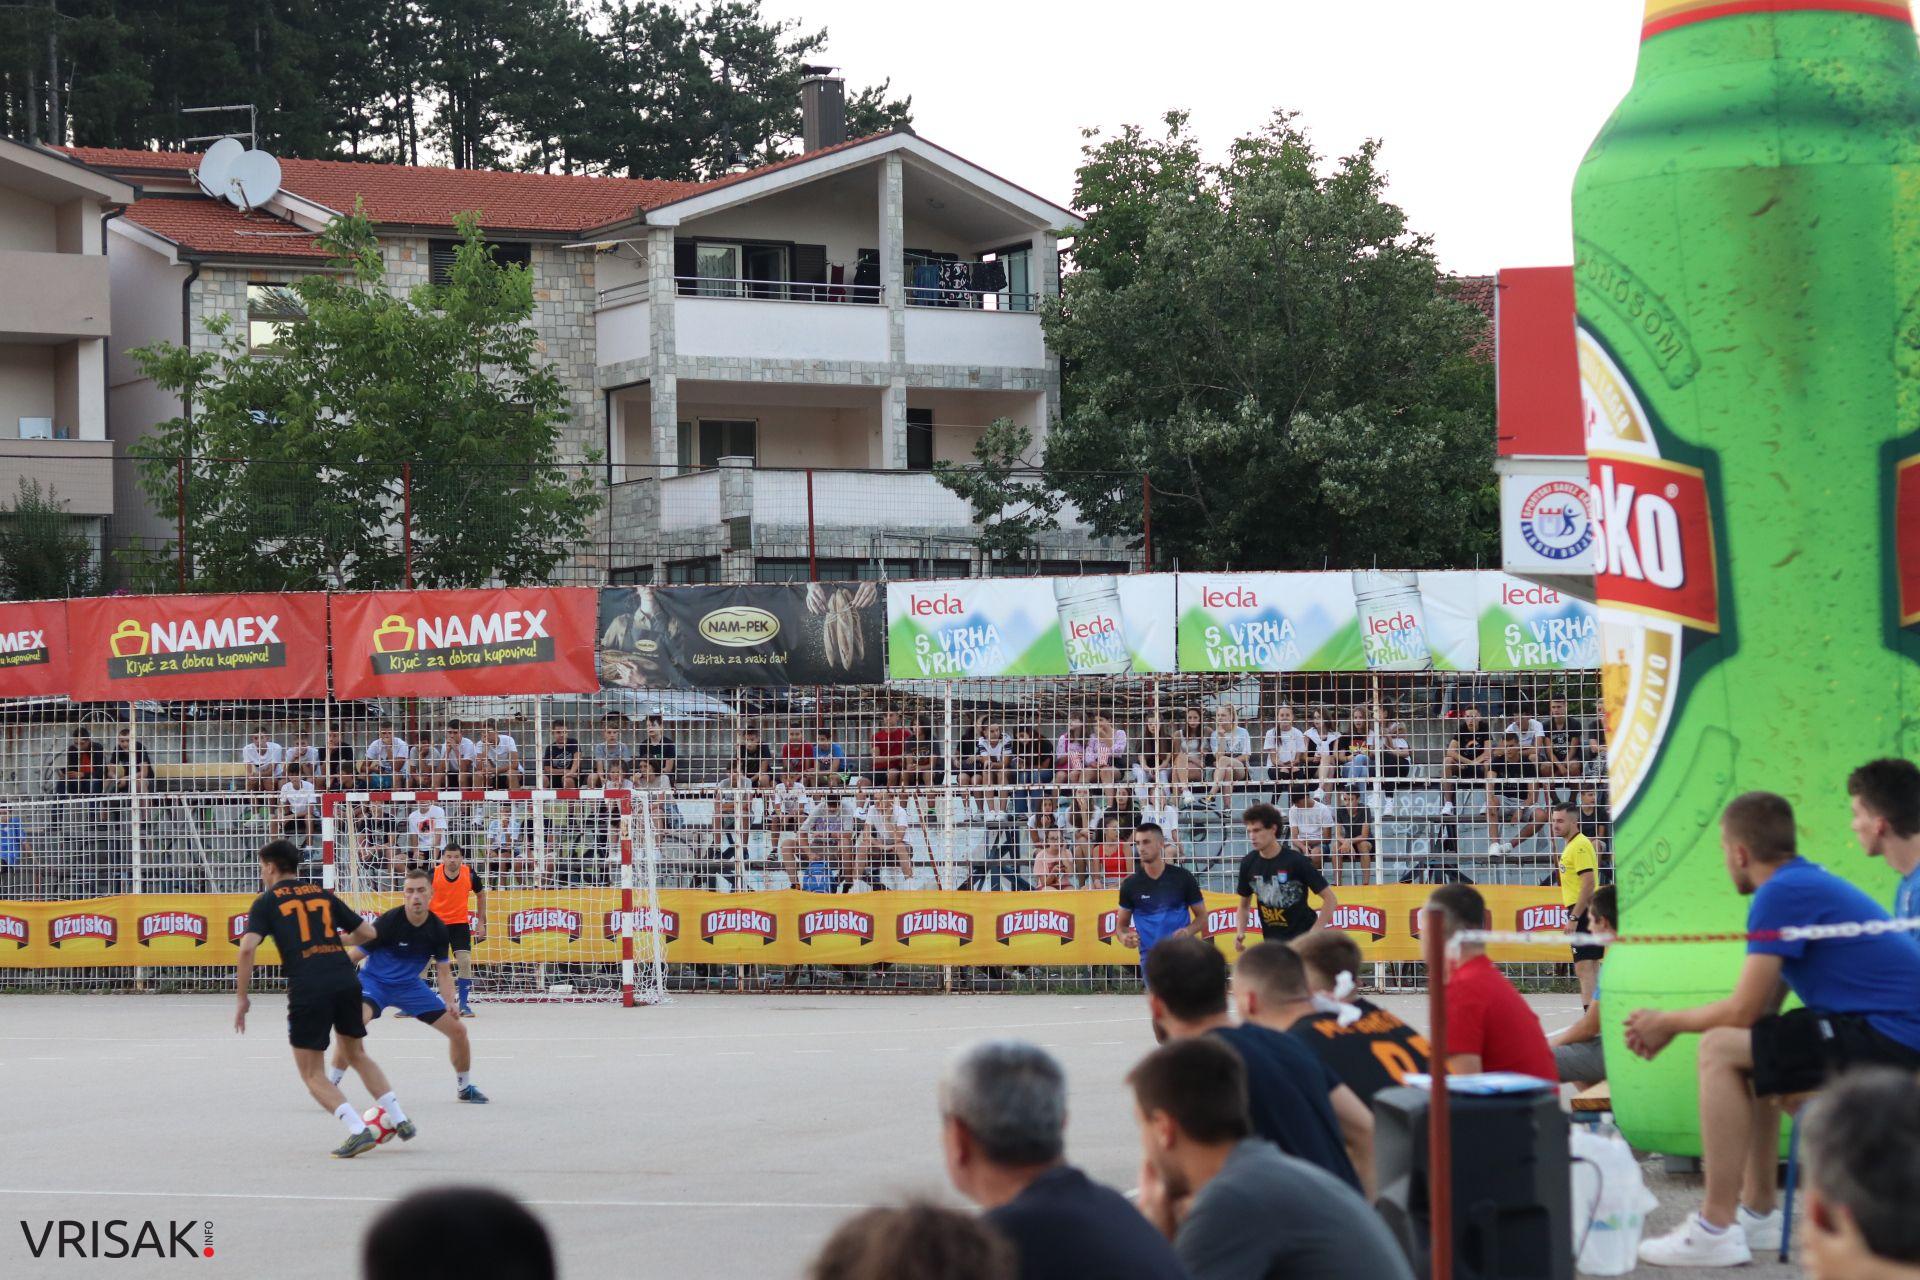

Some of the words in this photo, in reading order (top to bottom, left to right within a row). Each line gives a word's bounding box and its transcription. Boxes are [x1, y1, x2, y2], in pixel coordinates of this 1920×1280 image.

[911, 593, 964, 616] leda
[1203, 586, 1258, 608] leda
[1502, 583, 1560, 605] leda
[150, 614, 281, 655] NAMEX
[417, 609, 549, 651] NAMEX
[708, 620, 770, 634] NAM-PEK
[1070, 615, 1115, 639] leda
[1204, 626, 1221, 648] S
[1229, 618, 1297, 645] VRHA
[1368, 611, 1416, 635] leda
[1504, 624, 1522, 646] S
[1529, 615, 1596, 640] VRHA
[0, 629, 47, 653] MEX
[915, 634, 930, 654] S
[937, 623, 1000, 649] VRHA
[126, 659, 155, 677] Ključ
[160, 659, 178, 670] za
[182, 653, 214, 669] dobru
[390, 653, 422, 673] Ključ
[427, 656, 446, 668] za
[449, 650, 481, 666] dobru
[692, 652, 726, 665] Užitak
[728, 655, 742, 664] za
[744, 654, 767, 665] svaki
[916, 645, 1007, 676] VRHOVA
[1206, 640, 1300, 669] VRHOVA
[1641, 653, 1668, 718] PIVO
[54, 914, 113, 939] Ožujsko
[143, 913, 202, 937] Ožujsko
[278, 898, 335, 942] 77
[515, 908, 577, 933] Ožujsko
[707, 910, 771, 934] Ožujsko
[805, 910, 868, 934] Ožujsko
[903, 910, 968, 934] Ožujsko
[1003, 910, 1069, 935] Ožujsko
[1208, 910, 1263, 933] Ožusk
[1318, 906, 1380, 929] ujsko
[1523, 908, 1570, 931] Ožujs
